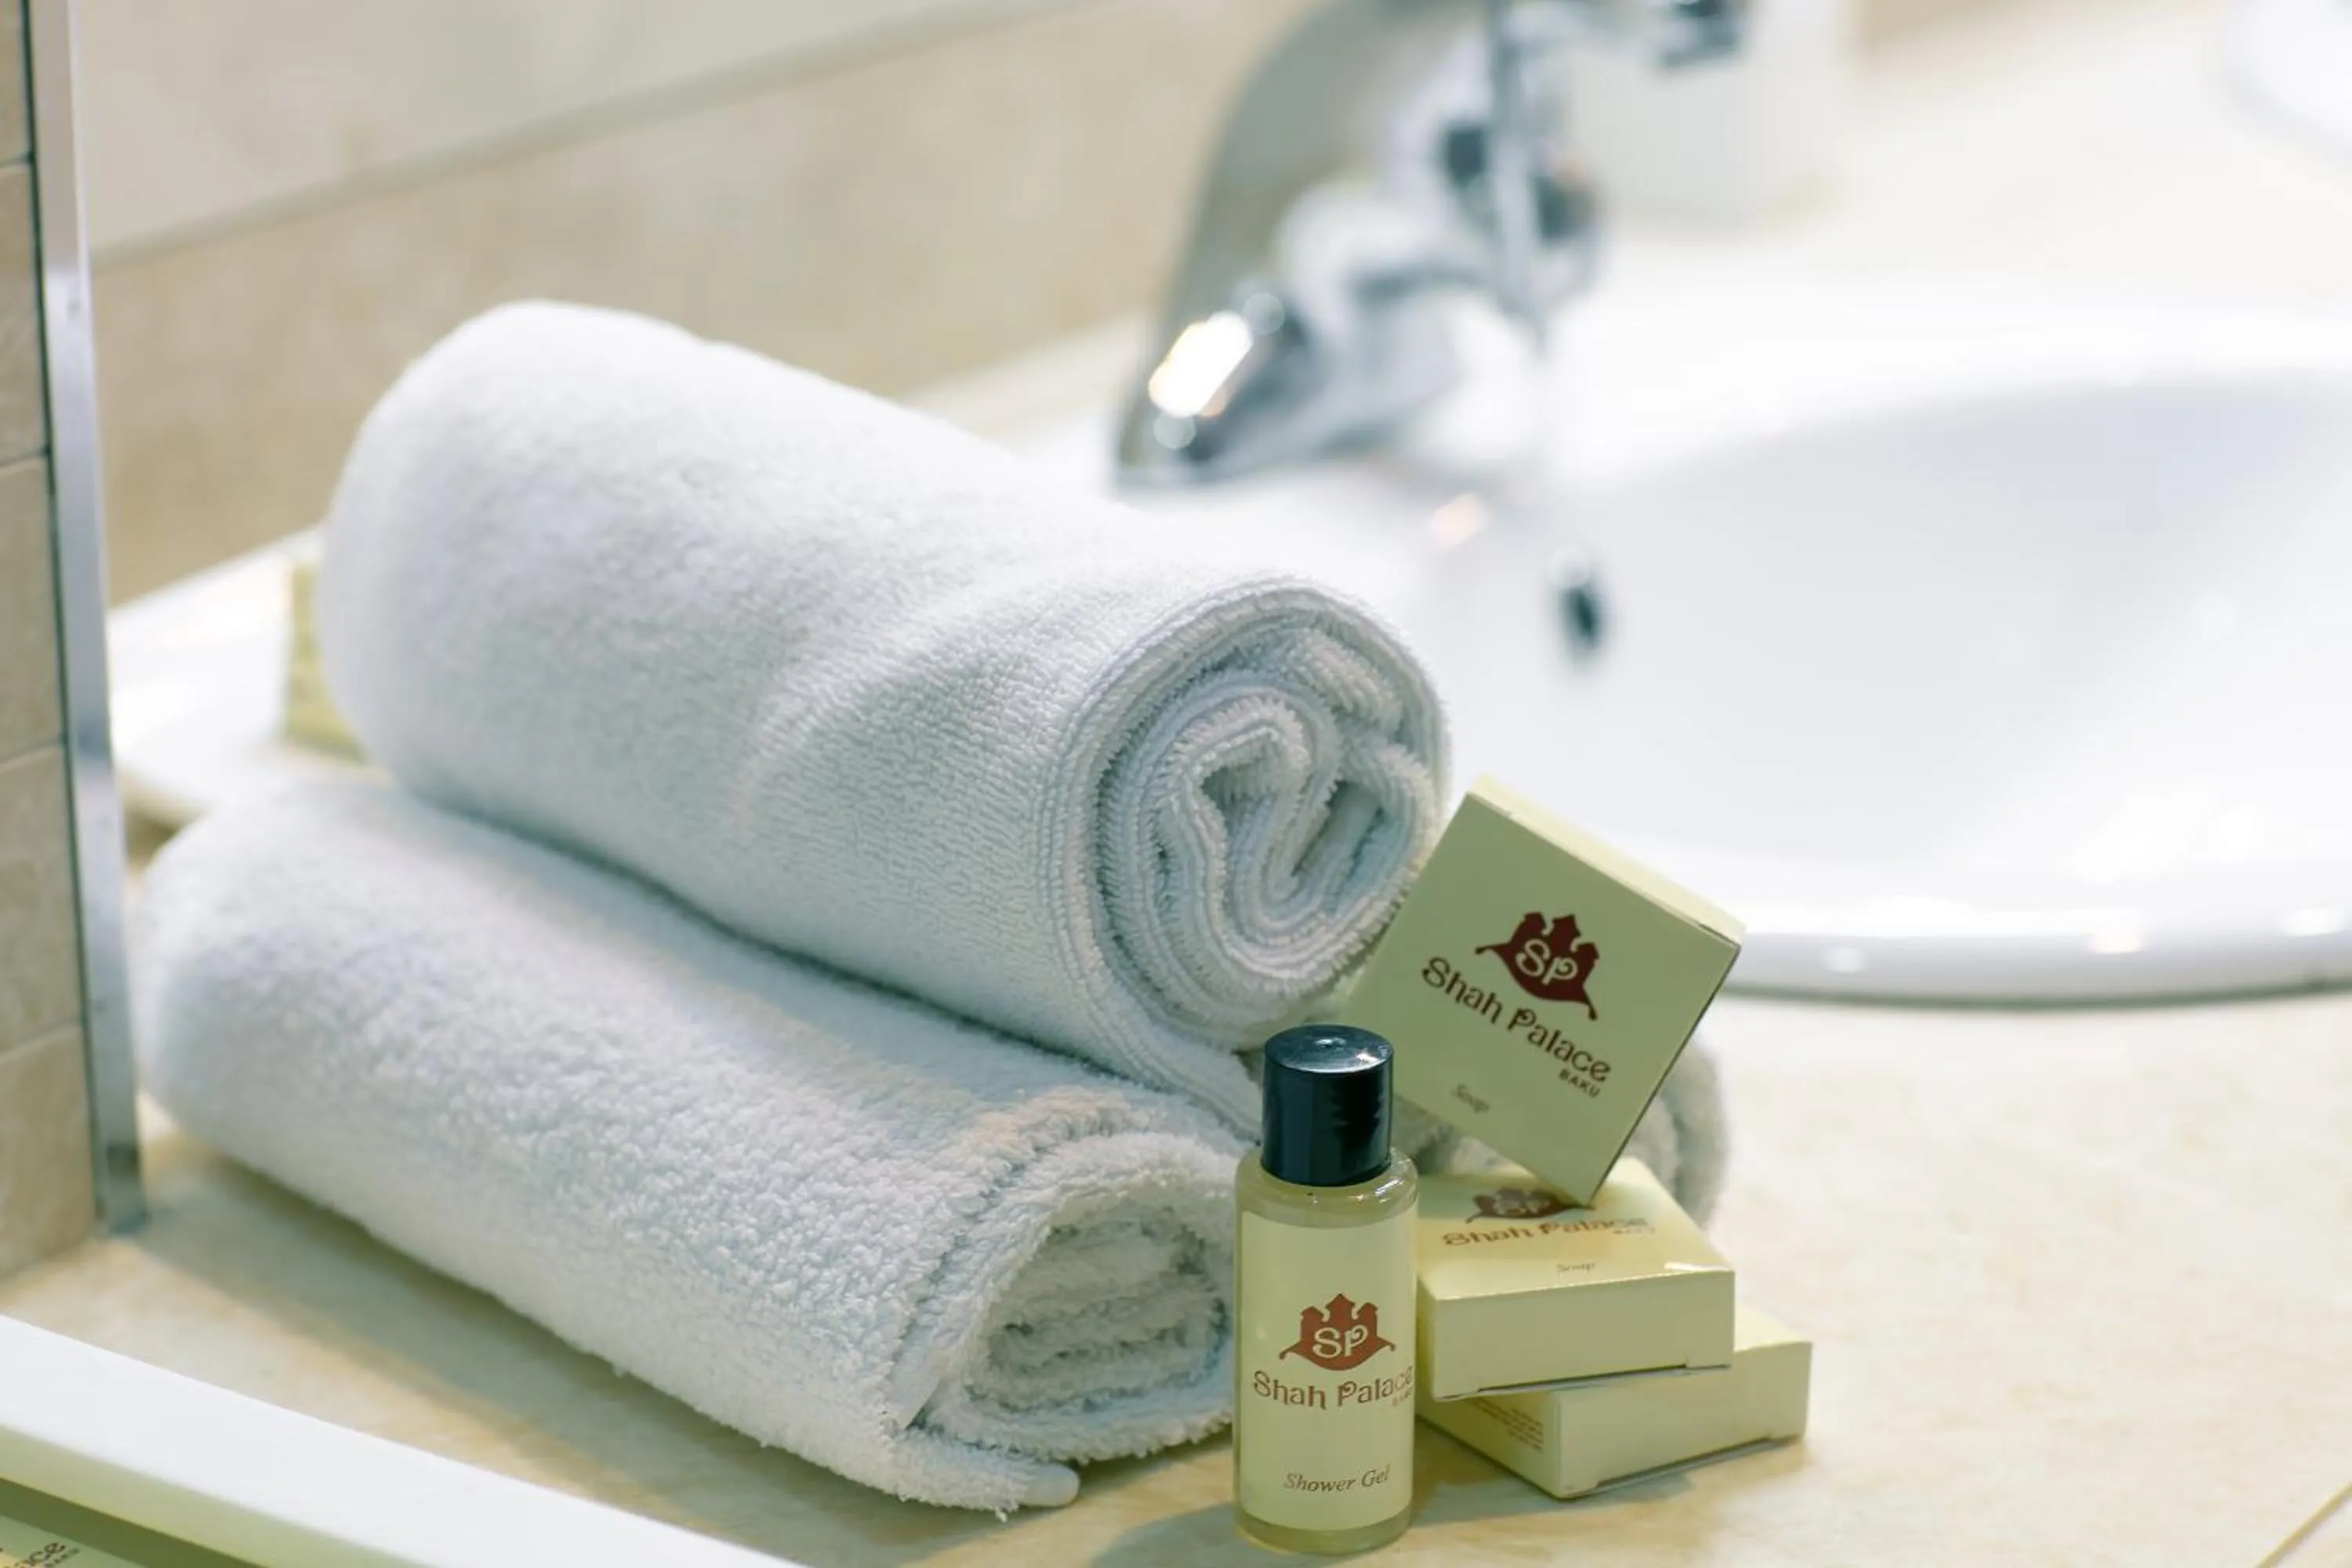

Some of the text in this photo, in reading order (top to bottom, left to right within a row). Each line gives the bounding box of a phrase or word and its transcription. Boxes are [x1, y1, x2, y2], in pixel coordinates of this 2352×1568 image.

[1421, 956, 1611, 1083] Shah Palace
[1558, 1068, 1601, 1098] BAKU
[1442, 1226, 1534, 1246] Shah
[1312, 1324, 1369, 1359] SP
[1253, 1370, 1327, 1410] Shah
[1283, 1462, 1392, 1493] Shower Gel
